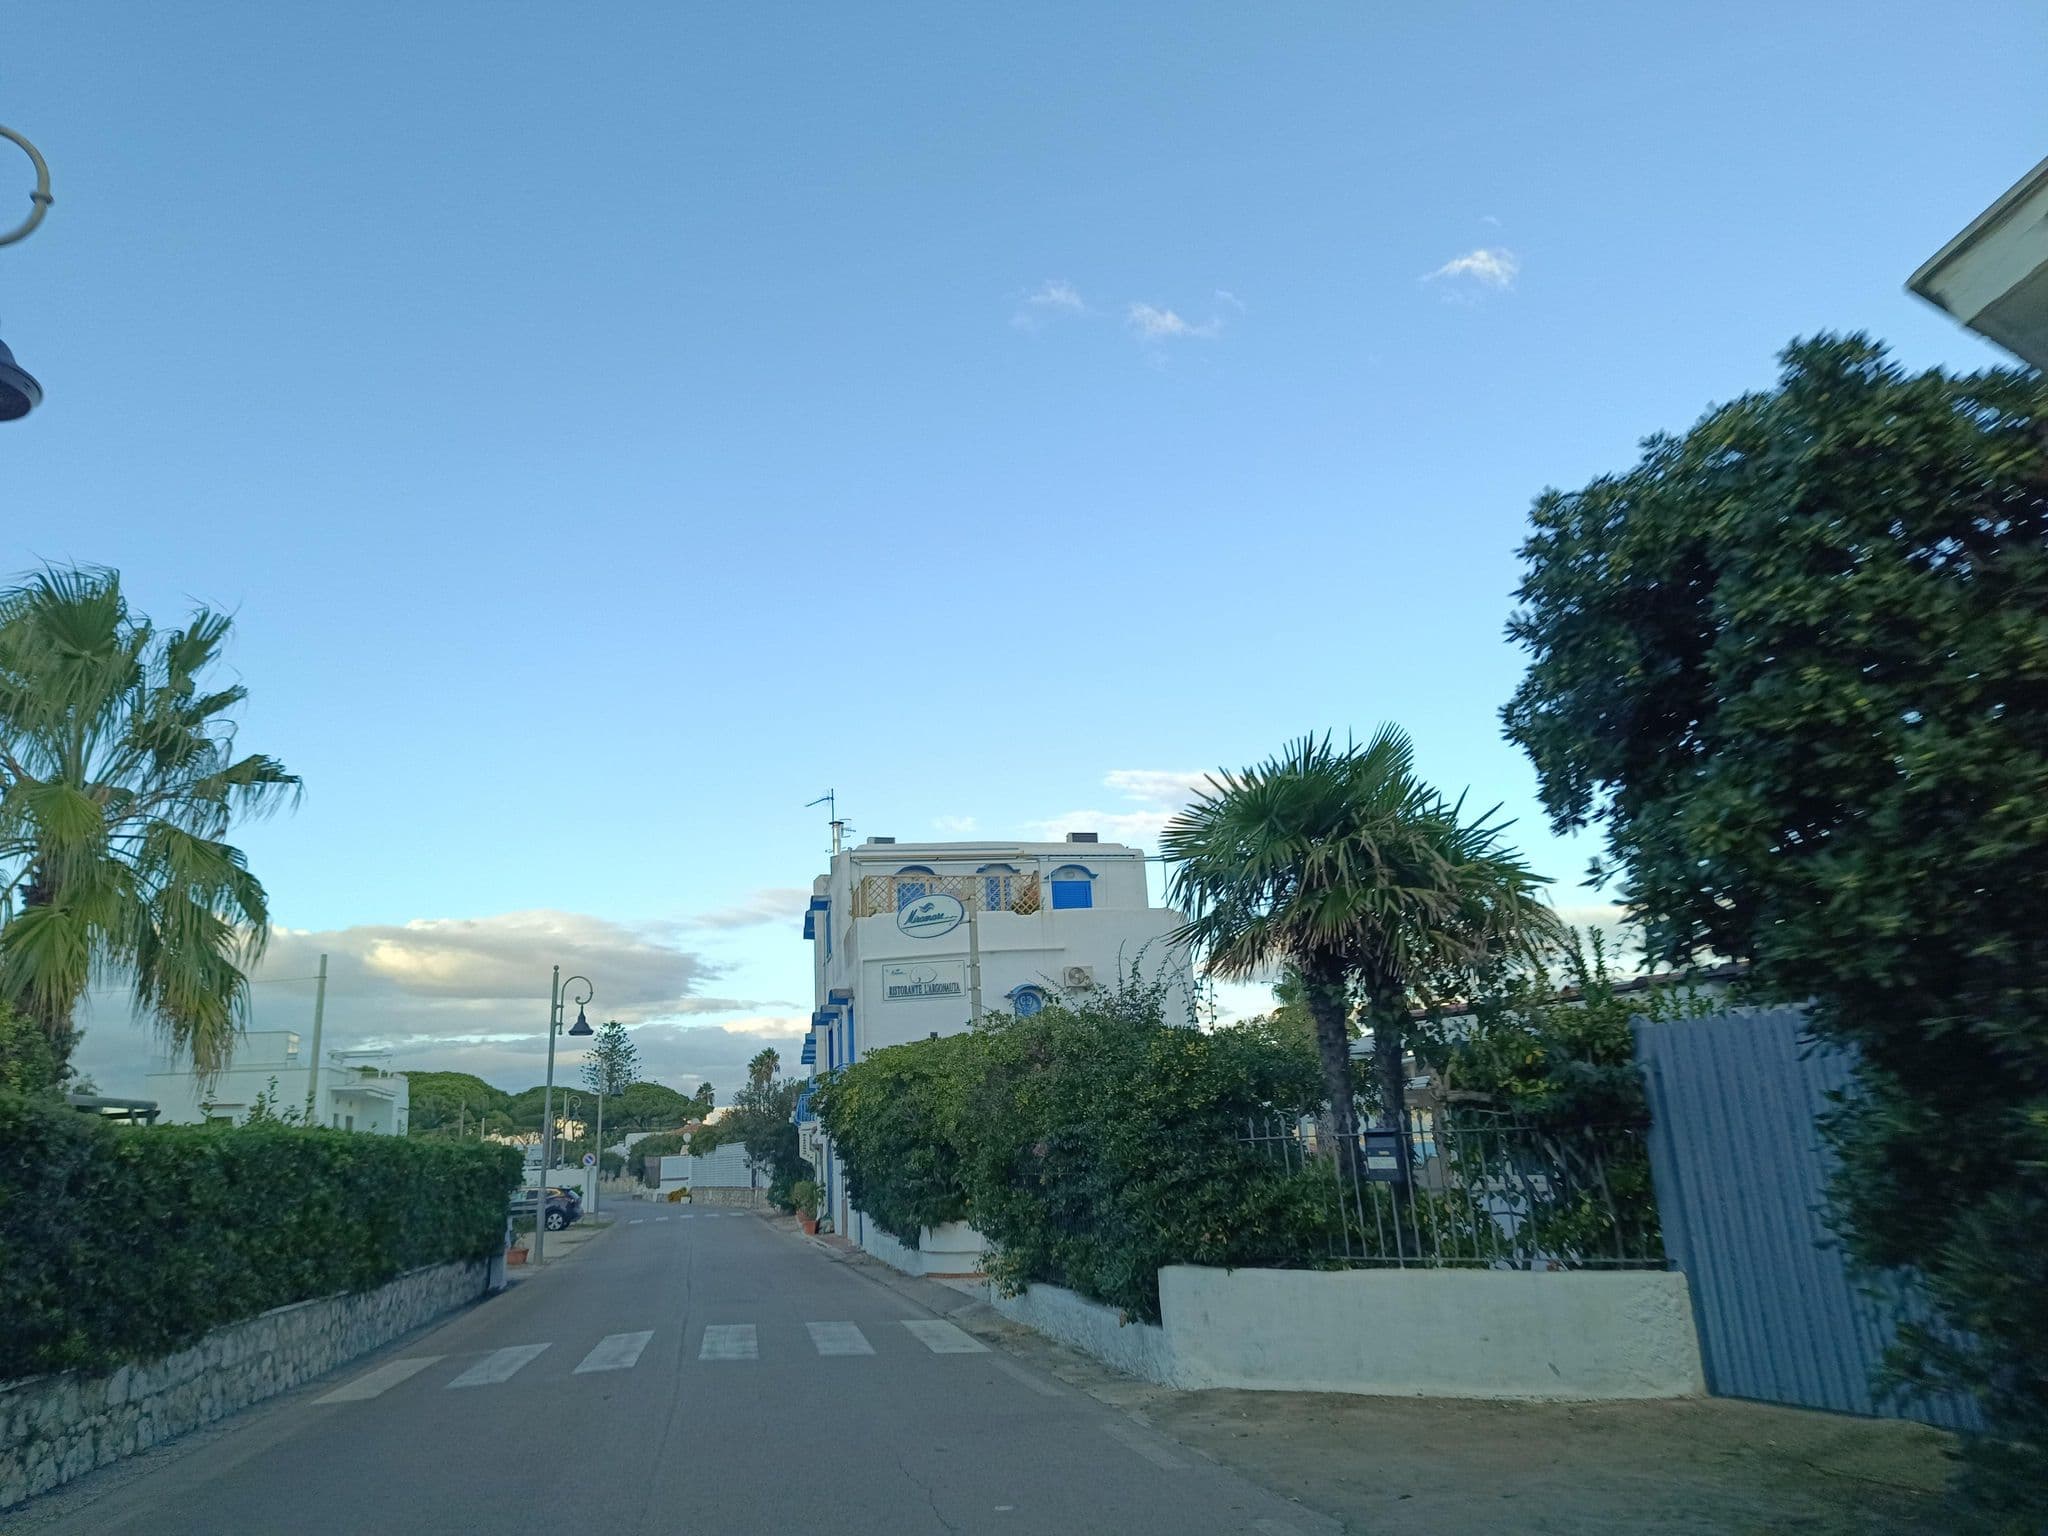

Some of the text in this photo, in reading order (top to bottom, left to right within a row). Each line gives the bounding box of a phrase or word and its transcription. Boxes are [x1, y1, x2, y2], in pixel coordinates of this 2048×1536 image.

[903, 909, 945, 925] Miramare
[888, 982, 961, 996] RISTORANTE L'ARGONAUTA
